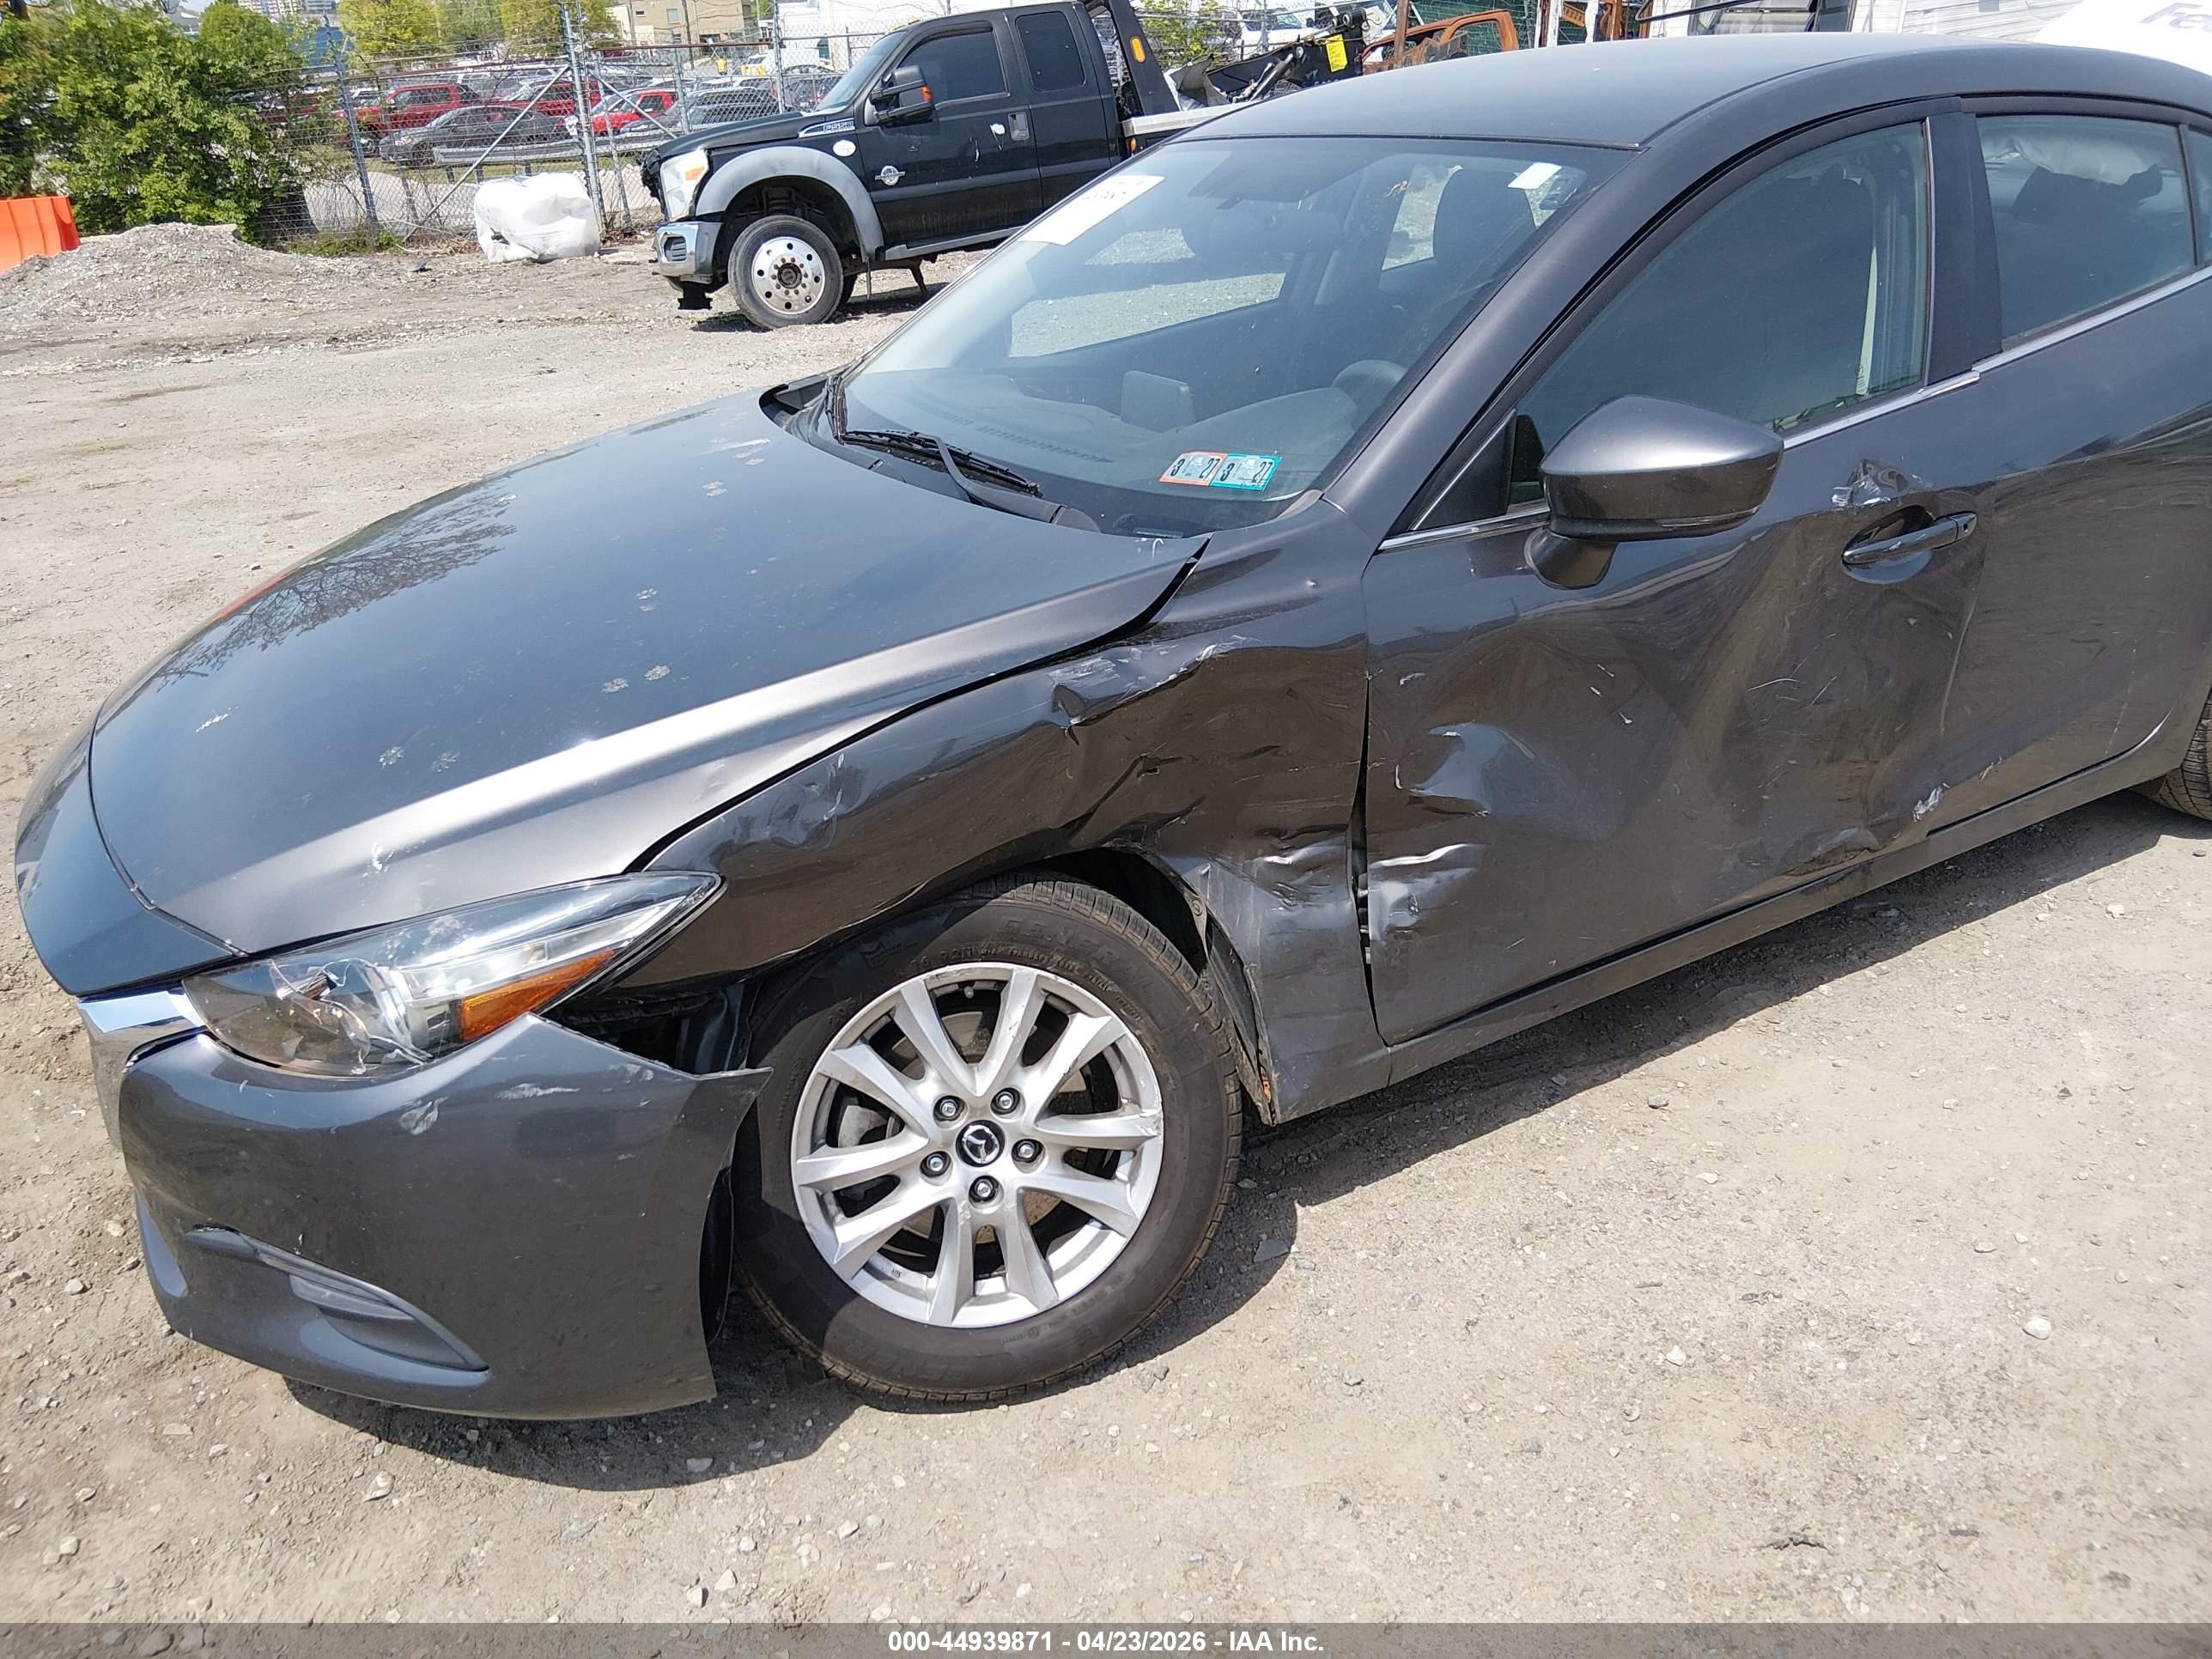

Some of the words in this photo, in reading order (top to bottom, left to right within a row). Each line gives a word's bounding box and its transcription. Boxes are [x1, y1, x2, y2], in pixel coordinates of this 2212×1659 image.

[1170, 459, 1186, 477] 3
[1199, 458, 1221, 480] 27
[1219, 463, 1235, 482] 3
[1250, 461, 1273, 483] 27
